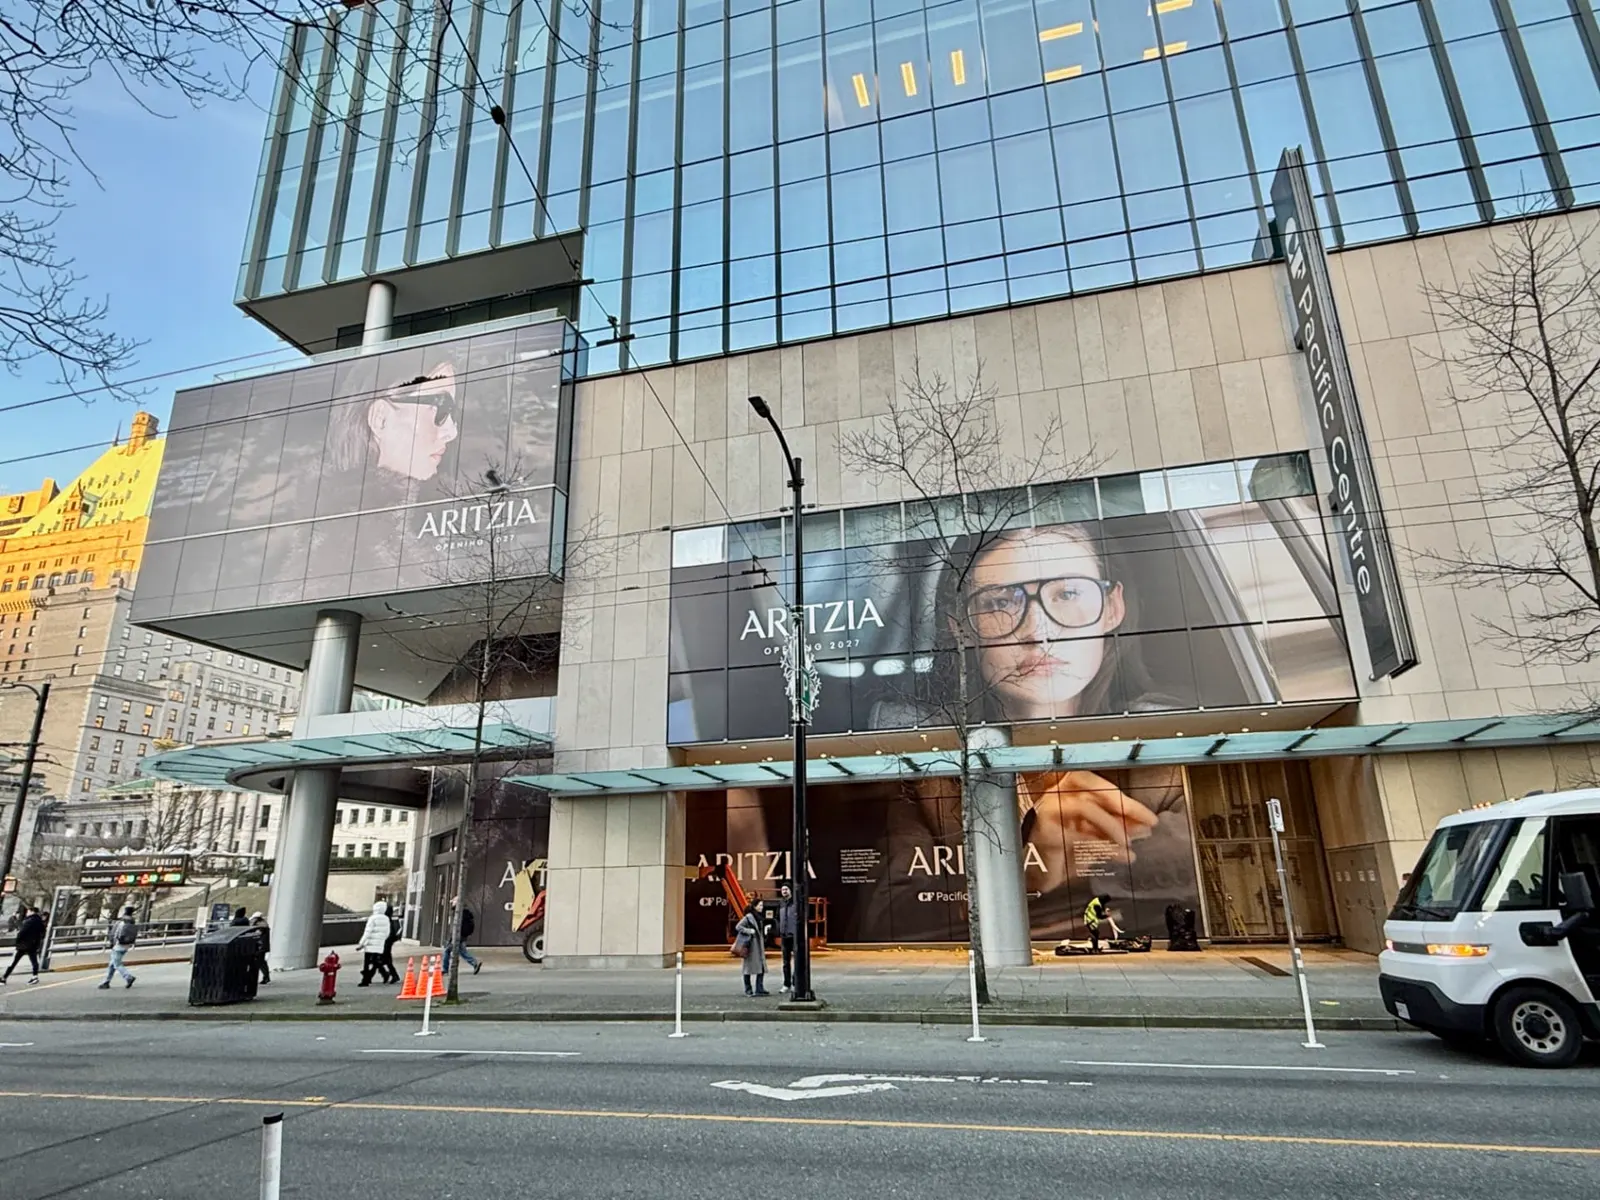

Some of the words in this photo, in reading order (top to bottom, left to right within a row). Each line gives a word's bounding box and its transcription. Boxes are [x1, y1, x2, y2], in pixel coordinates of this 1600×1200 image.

[1299, 284, 1334, 429] Pacific
[1332, 436, 1370, 594] Centre
[417, 499, 536, 539] ARITZIA
[435, 539, 483, 552] OPENING
[740, 599, 884, 640] ARTZIA
[829, 639, 860, 650] 2027
[151, 858, 182, 866] PARKING
[907, 842, 1049, 877] ARIA
